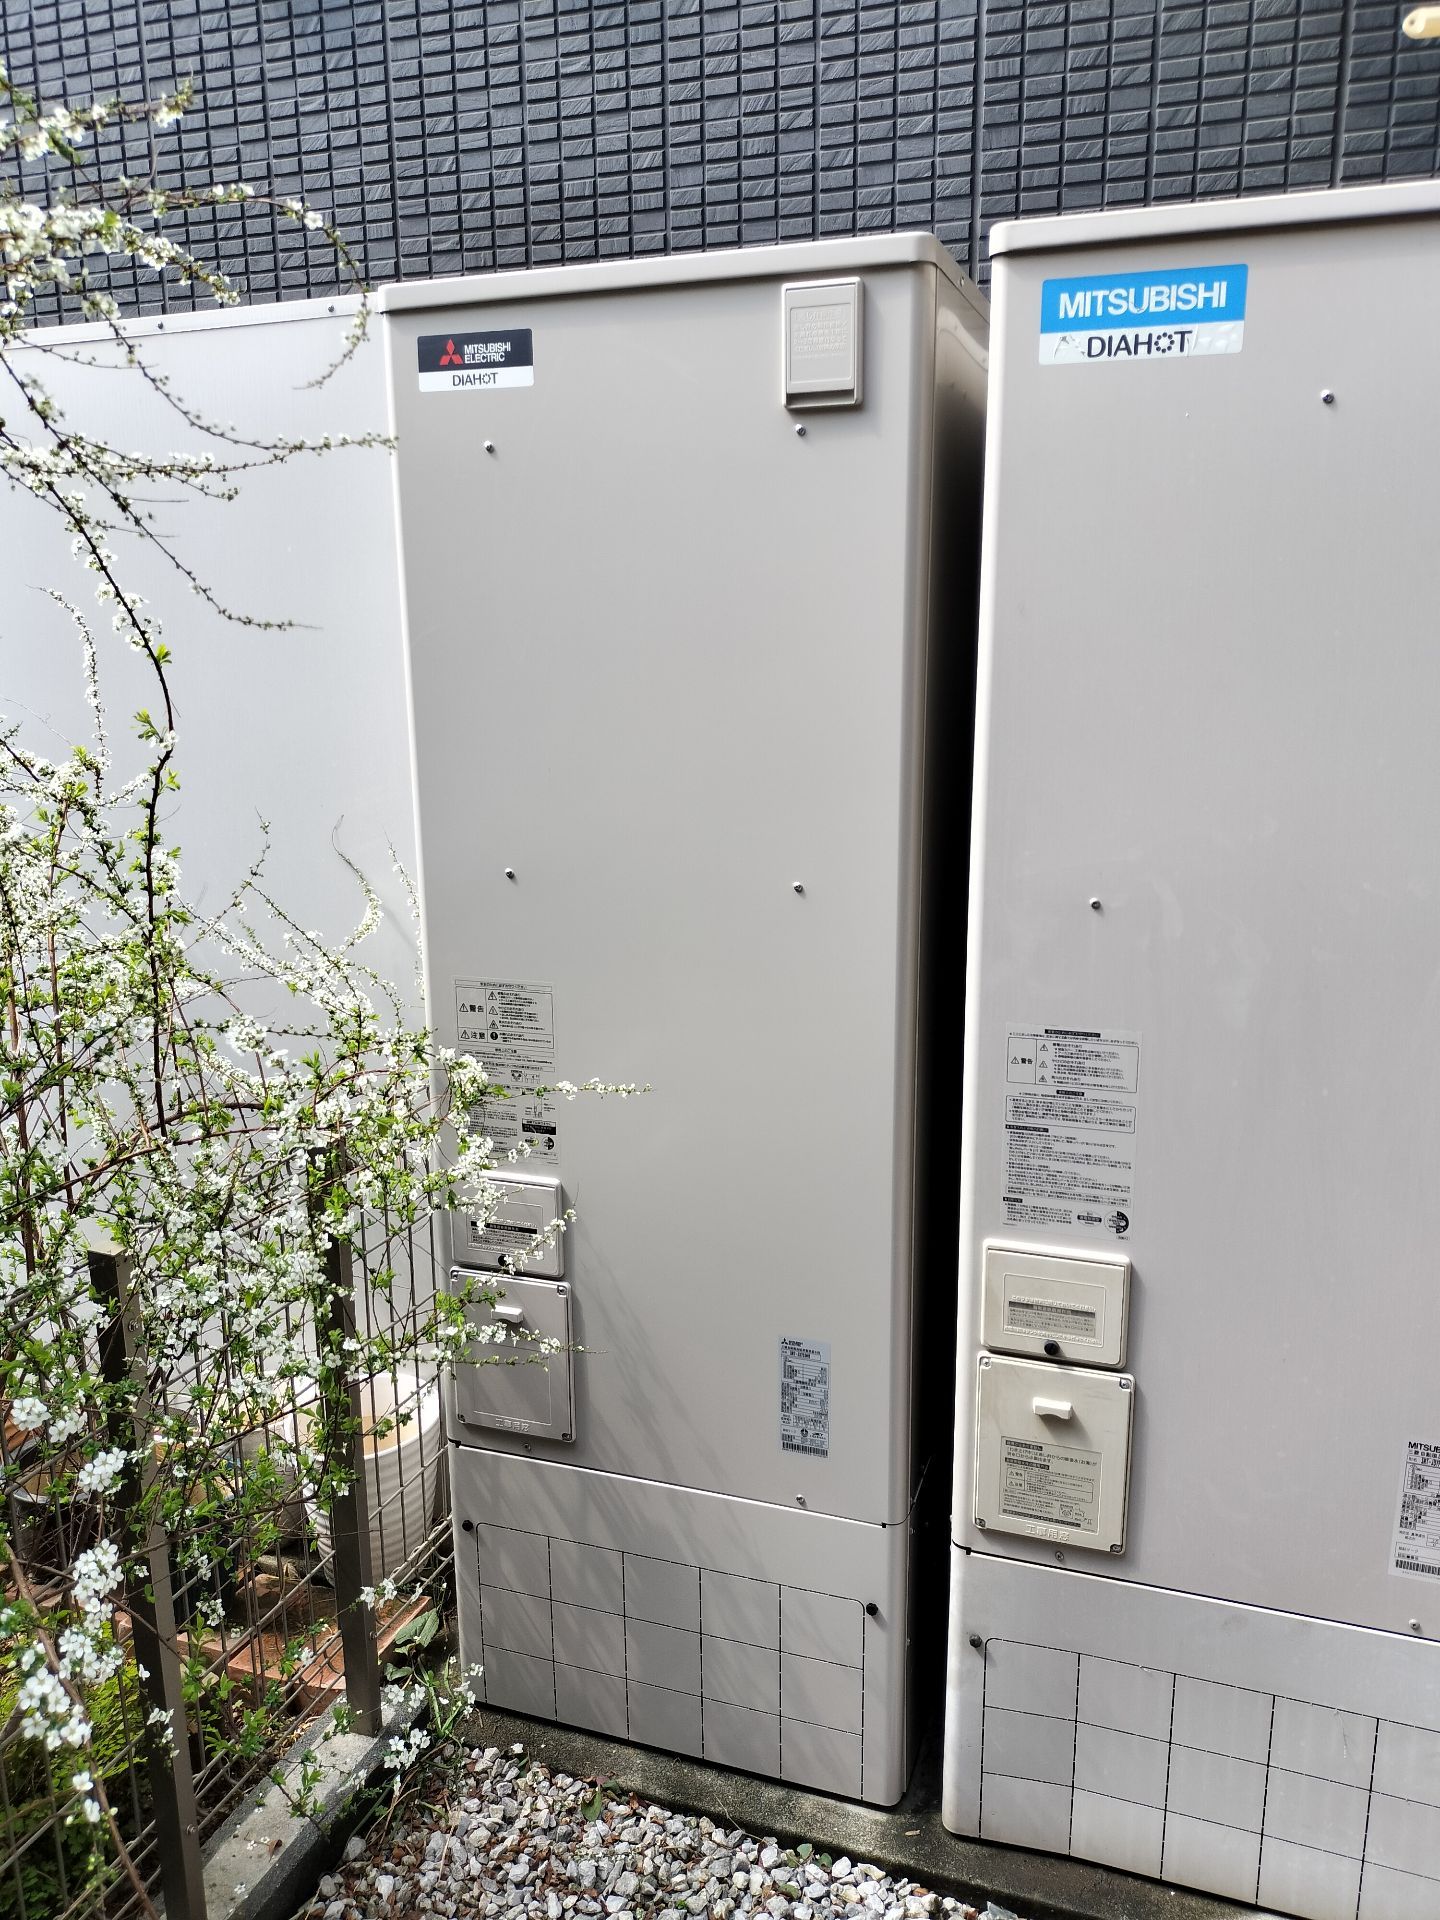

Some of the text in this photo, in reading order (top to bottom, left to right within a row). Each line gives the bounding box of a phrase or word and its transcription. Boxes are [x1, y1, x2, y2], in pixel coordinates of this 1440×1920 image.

[1059, 281, 1227, 320] MITSUBISHI
[464, 341, 511, 354] MITSUBISHI
[1087, 329, 1193, 359] DIAHOT
[464, 352, 505, 364] ELECTRIC
[452, 372, 498, 387] DIAHOT
